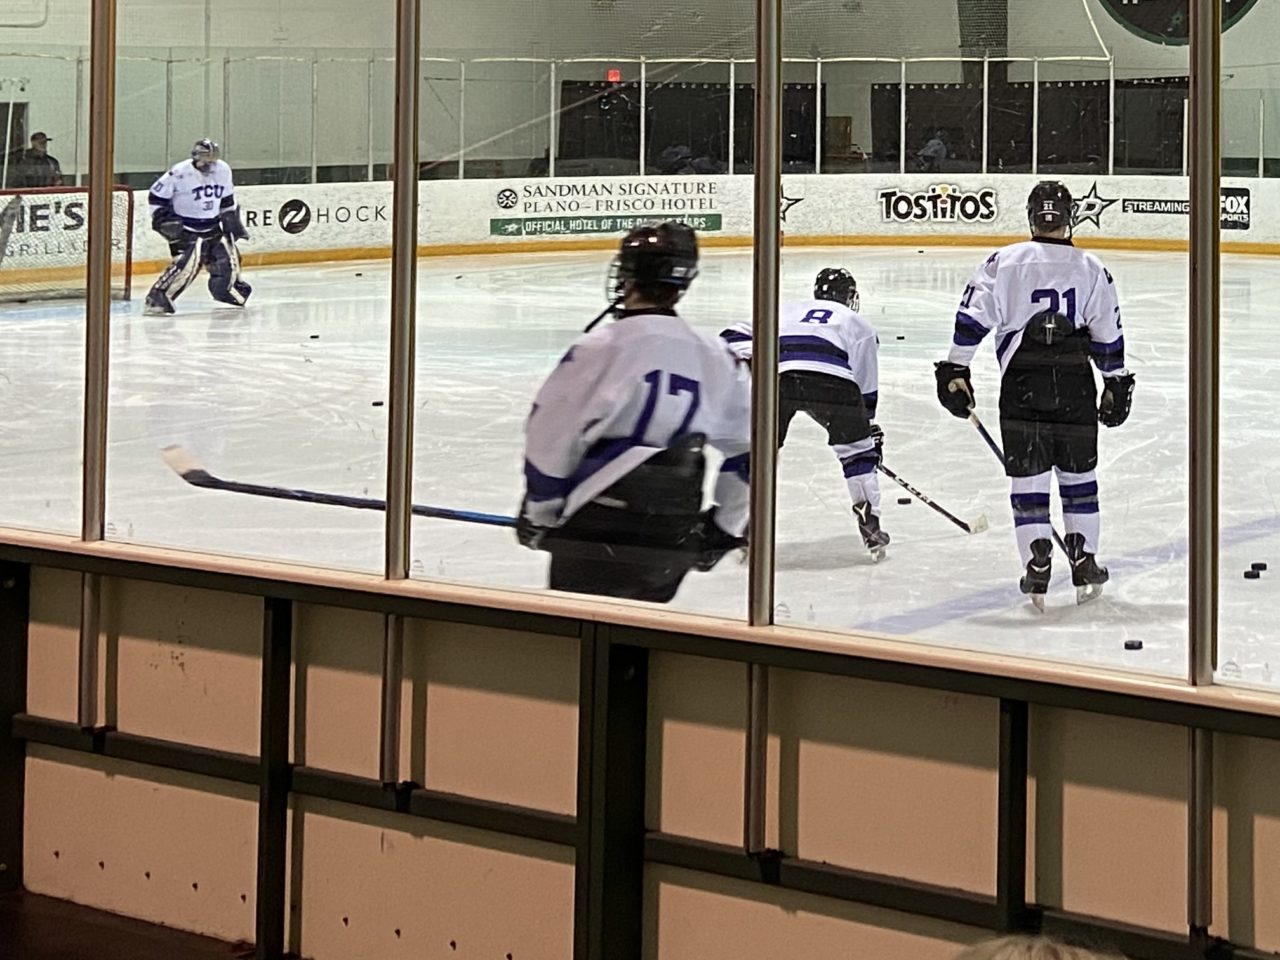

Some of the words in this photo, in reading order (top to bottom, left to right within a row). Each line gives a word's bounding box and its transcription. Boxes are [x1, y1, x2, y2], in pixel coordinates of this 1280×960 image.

[192, 185, 225, 201] TCU
[523, 183, 613, 198] SANDMAN
[618, 182, 718, 197] SIGNATURE
[661, 196, 718, 211] HOTEL
[1124, 201, 1190, 213] STREAMING
[246, 210, 272, 227] RE
[317, 205, 388, 223] HOCK
[525, 220, 567, 232] OFFICIAL
[569, 219, 598, 230] HOTEL
[601, 219, 614, 230] OF
[616, 218, 634, 229] THE
[642, 369, 700, 444] 17
